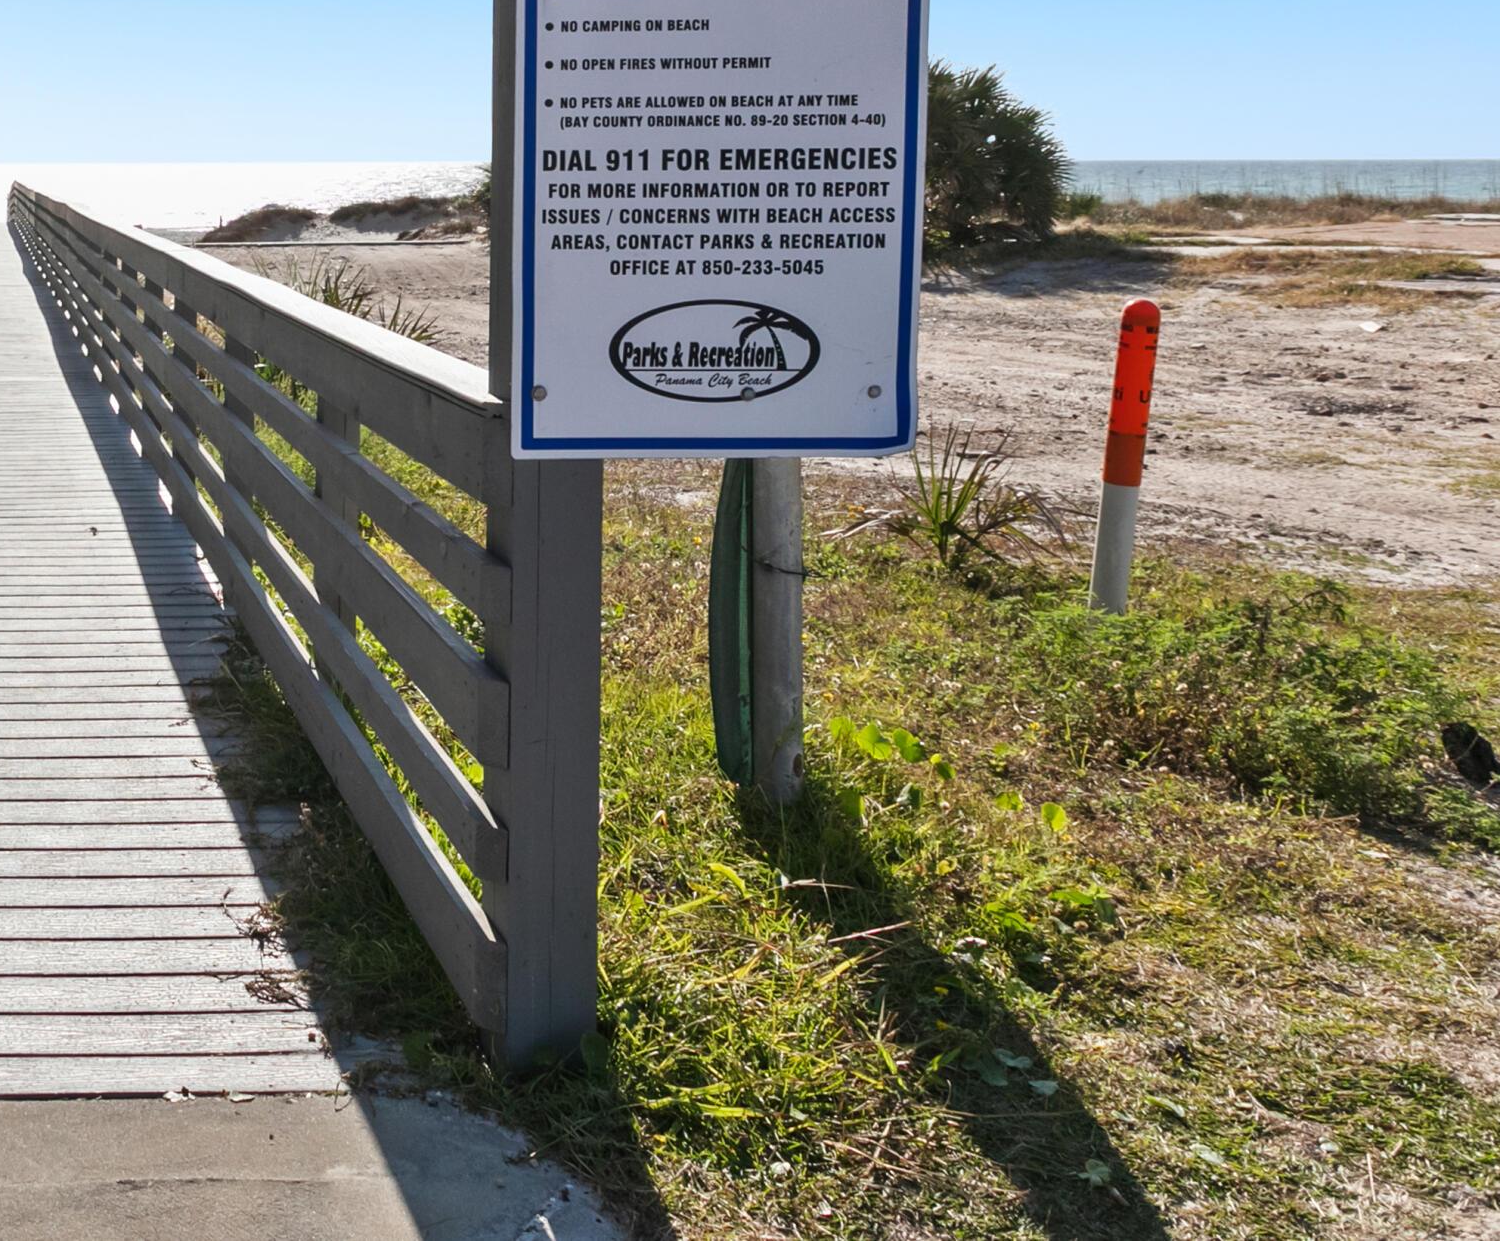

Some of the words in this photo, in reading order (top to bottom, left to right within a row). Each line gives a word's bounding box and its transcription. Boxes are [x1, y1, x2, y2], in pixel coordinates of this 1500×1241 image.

[560, 20, 578, 32] NO
[581, 19, 641, 32] CAMPING
[644, 19, 662, 31] ON
[666, 18, 709, 31] BEACH
[560, 58, 577, 71] NO
[581, 58, 615, 70] OPEN
[619, 57, 655, 70] FIRES
[659, 56, 718, 69] WITHOUT
[722, 56, 771, 69] PERMIT
[542, 149, 596, 171] DIAL
[605, 148, 648, 171] 911
[661, 148, 709, 171] FOR
[719, 147, 896, 170] EMERGENCIES
[609, 259, 669, 275] OFFICE
[674, 259, 696, 275] AT
[701, 259, 823, 275] 850-233-5045
[622, 342, 668, 367] Parks
[672, 341, 684, 367] &
[688, 341, 775, 367] Recreation
[655, 373, 703, 386] Panama
[708, 373, 734, 389] City
[738, 373, 772, 386] Beach
